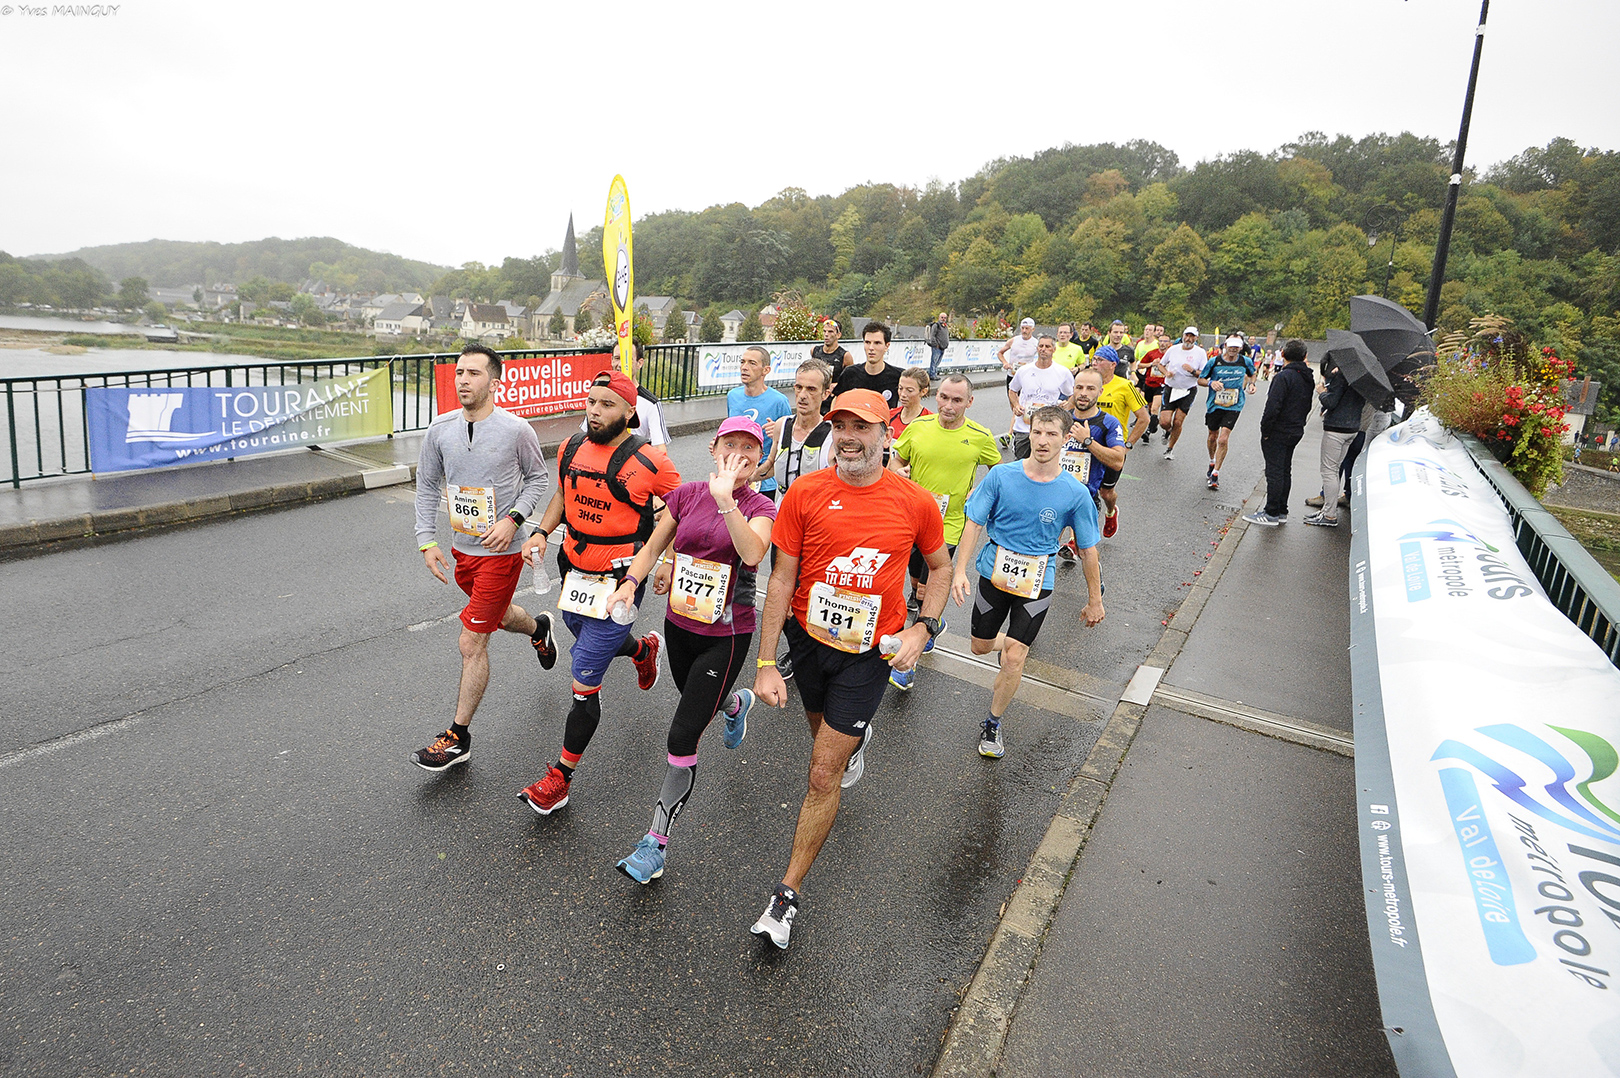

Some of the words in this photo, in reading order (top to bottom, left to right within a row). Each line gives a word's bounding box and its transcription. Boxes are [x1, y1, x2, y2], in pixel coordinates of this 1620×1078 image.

[783, 350, 803, 360] Tours
[215, 376, 370, 418] TOURAINE
[494, 377, 591, 404] République
[222, 420, 243, 438] LE
[175, 425, 331, 459] www.touraine.fr
[1061, 457, 1076, 465] Greg
[454, 495, 477, 504] Amine
[574, 494, 611, 511] ADRIEN
[455, 503, 479, 517] 866
[578, 509, 603, 524] 3H45
[1004, 555, 1030, 567] Gregoire
[1403, 550, 1421, 564] Val
[681, 566, 713, 581] Pascale
[1002, 563, 1028, 578] 841
[1036, 560, 1045, 578] 4h00
[1405, 563, 1422, 573] de
[1437, 546, 1473, 597] métropole
[678, 576, 715, 597] 1277
[718, 574, 728, 596] 3h45
[825, 571, 838, 585] TO
[839, 573, 854, 587] BE
[856, 574, 873, 589] TRI
[1033, 578, 1041, 593] SAS
[1407, 571, 1425, 592] Loire
[570, 589, 595, 606] 901
[714, 597, 723, 616] SAS
[817, 595, 861, 615] Thomas
[820, 608, 854, 630] 181
[866, 605, 878, 628] 3h45
[1456, 804, 1488, 848] Val
[1469, 856, 1498, 879] de
[1377, 834, 1409, 948] www.tours-metropole.fr
